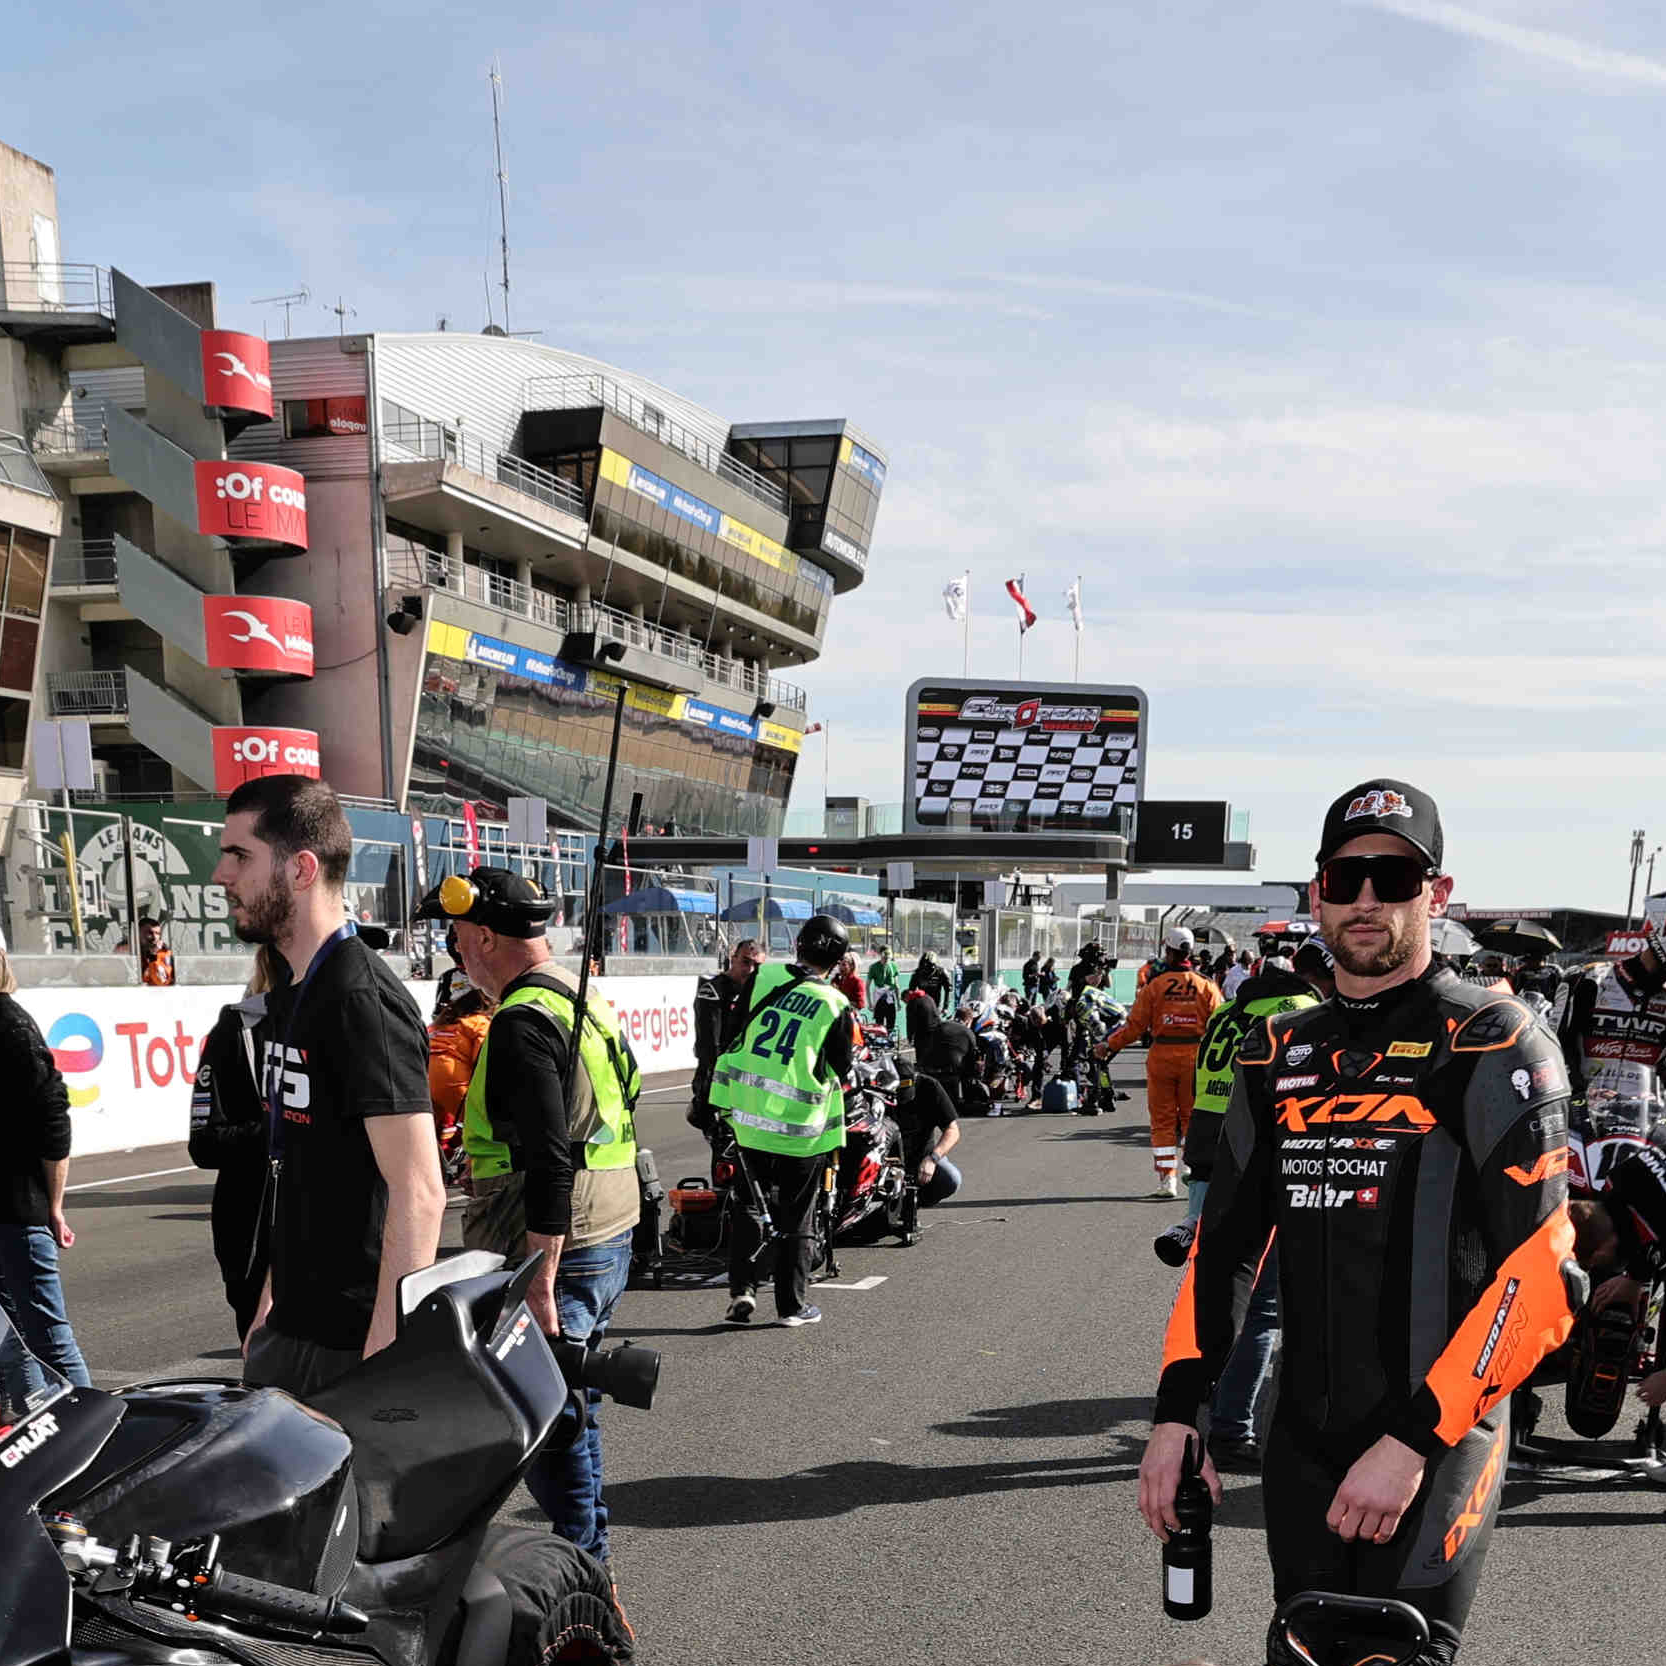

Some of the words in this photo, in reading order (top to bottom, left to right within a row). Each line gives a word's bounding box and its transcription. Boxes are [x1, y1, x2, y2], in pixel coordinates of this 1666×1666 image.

[1171, 824, 1193, 839] 15
[751, 1009, 802, 1066] 24
[1205, 1077, 1233, 1098] MÉDI
[1276, 1074, 1318, 1091] MOTUL
[1282, 1158, 1323, 1175] MOTOS
[1325, 1158, 1388, 1177] ROCHAT
